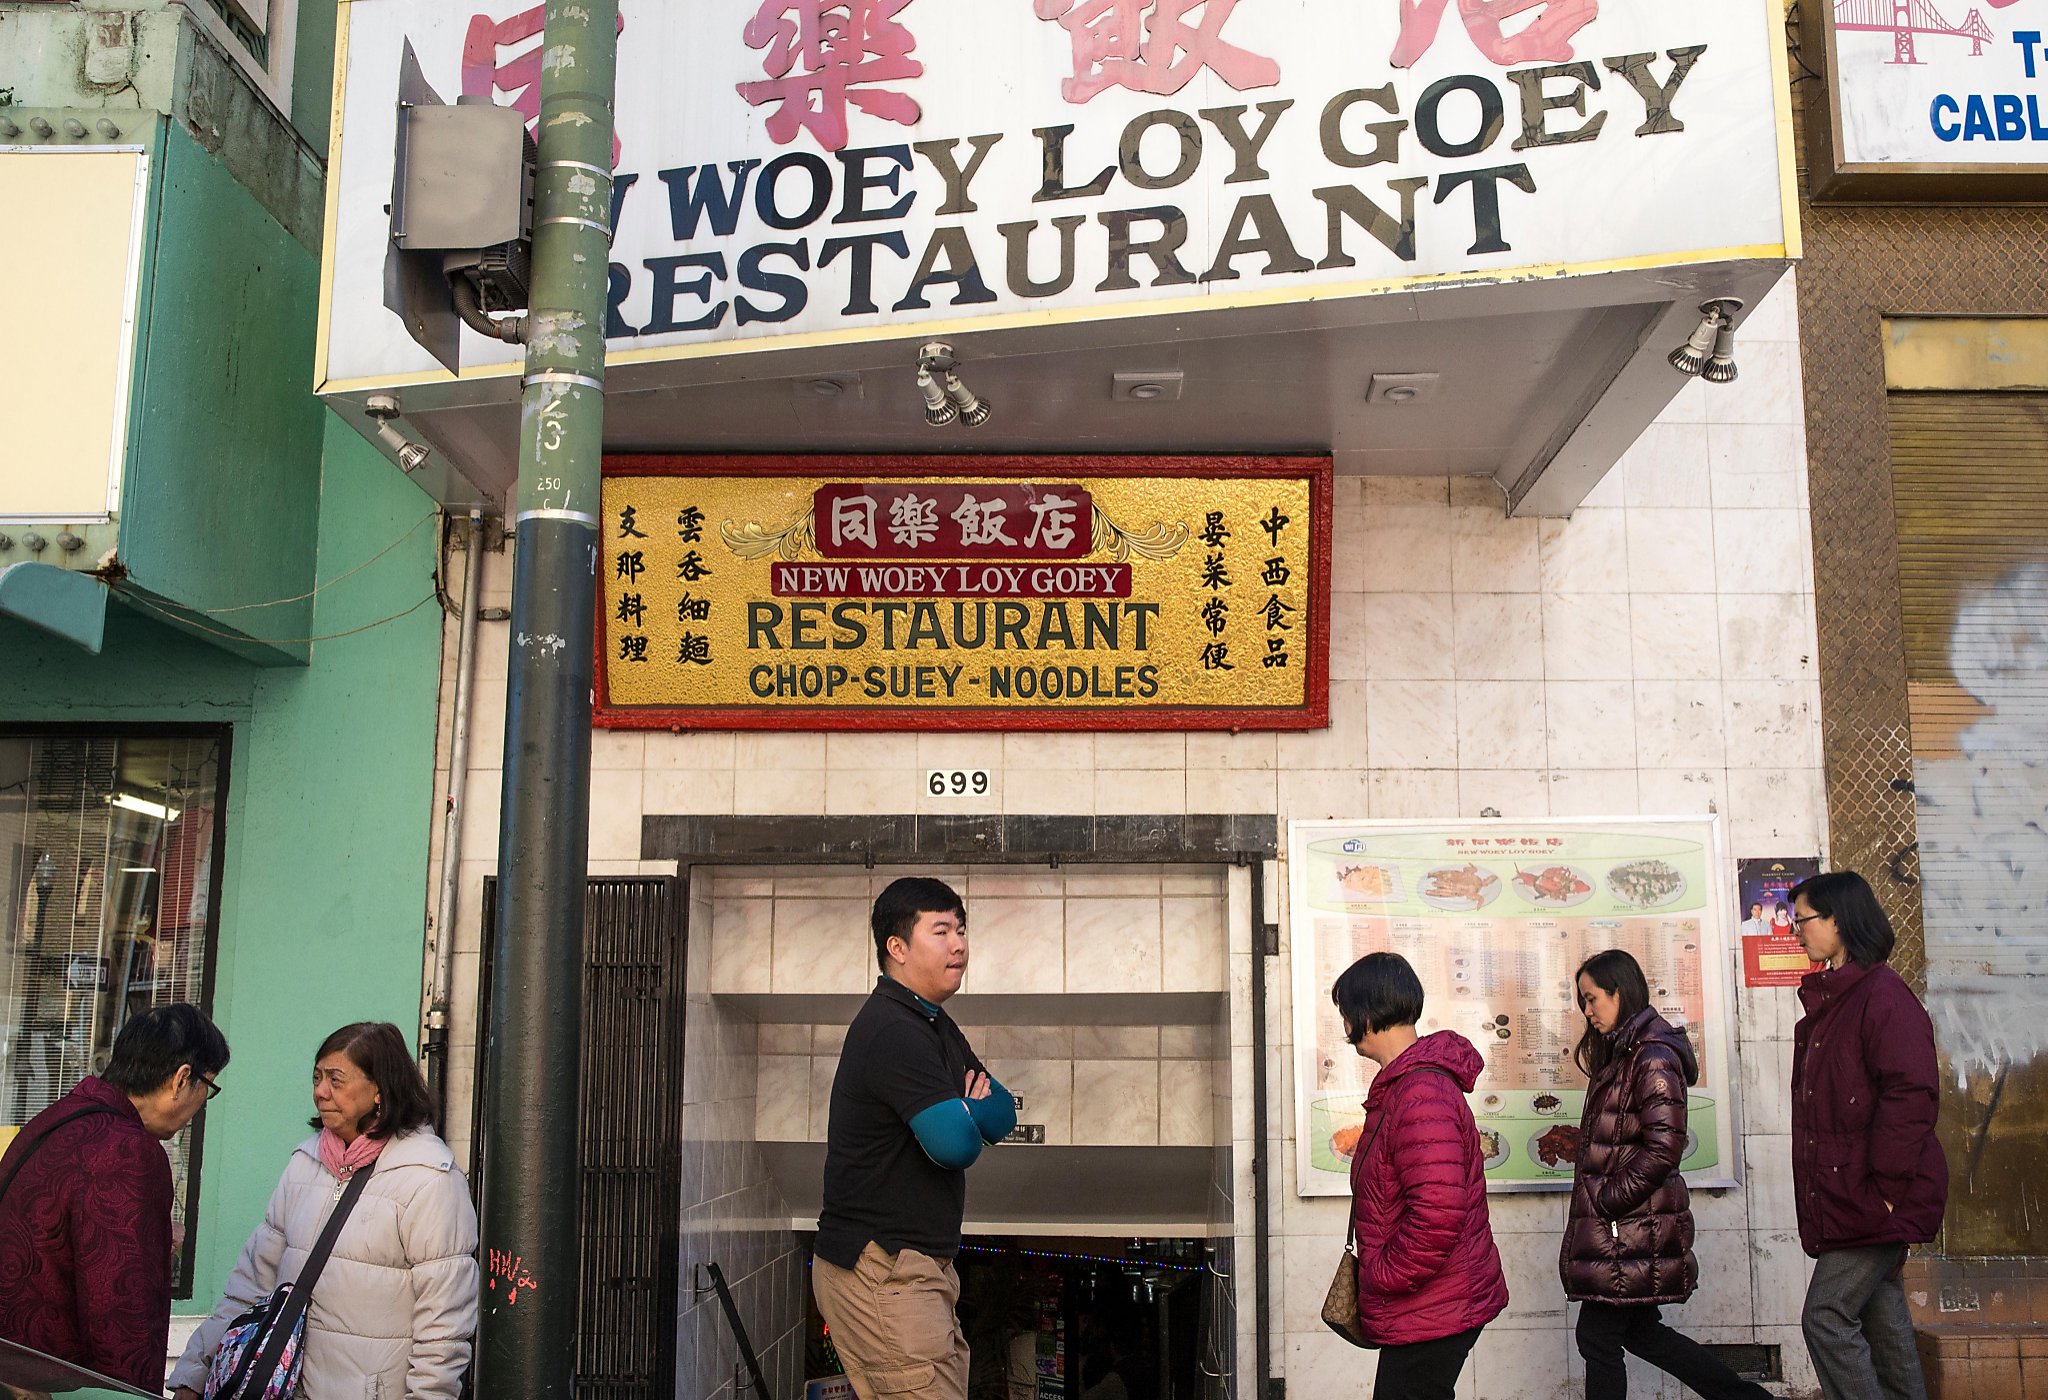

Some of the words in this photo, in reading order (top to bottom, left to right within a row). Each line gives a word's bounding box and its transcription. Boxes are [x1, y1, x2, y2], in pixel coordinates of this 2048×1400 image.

[658, 133, 1003, 241] WOEY
[1031, 98, 1295, 203] LOY
[1319, 44, 1708, 168] GOEY
[537, 477, 561, 491] 250
[831, 493, 1078, 550] 同樂飯店
[616, 504, 649, 663] 支那料理
[779, 567, 852, 593] NEW
[856, 566, 951, 593] WOEY
[956, 566, 1028, 593] LOY
[1031, 566, 1123, 594] GOEY
[1256, 506, 1297, 669] 中西食品
[747, 601, 1160, 651] RESTAURANT
[929, 771, 988, 795] 699
